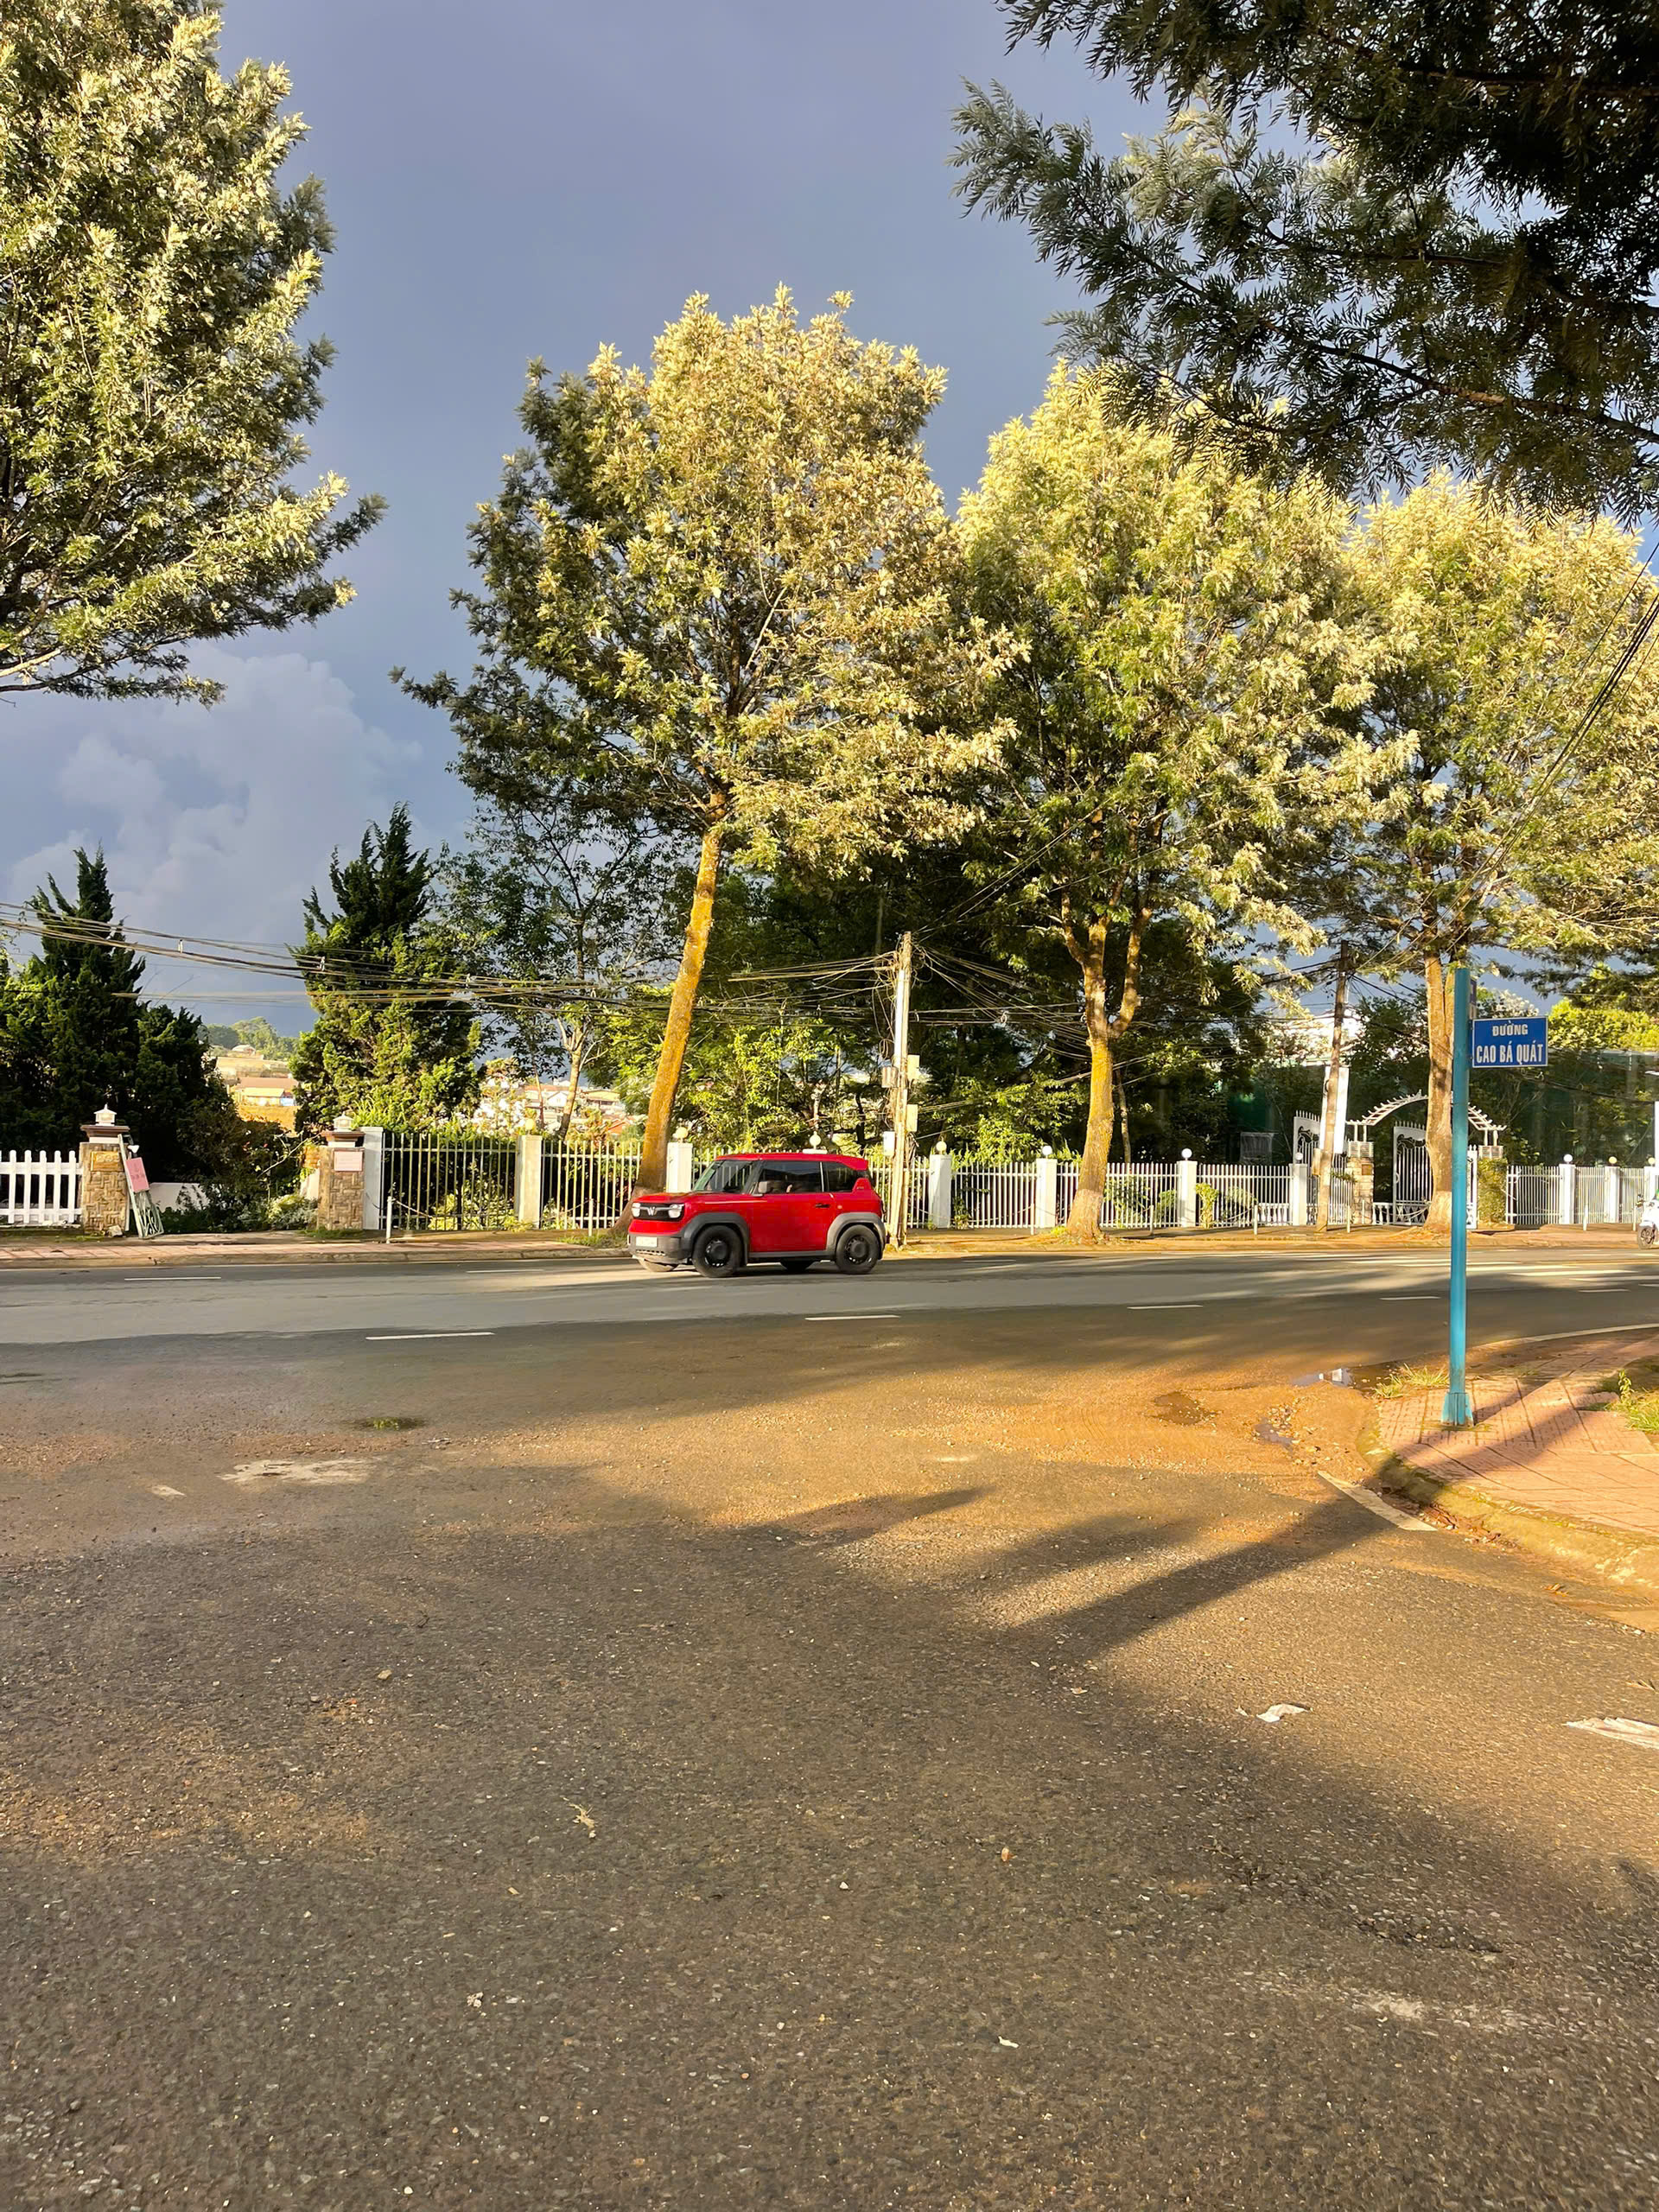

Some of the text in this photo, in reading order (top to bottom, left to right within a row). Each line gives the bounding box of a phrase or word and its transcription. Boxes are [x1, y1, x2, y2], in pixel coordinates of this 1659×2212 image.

[1492, 1020, 1529, 1036] ĐƯỜNG
[1476, 1039, 1543, 1065] CAO BÁ QUÁT
